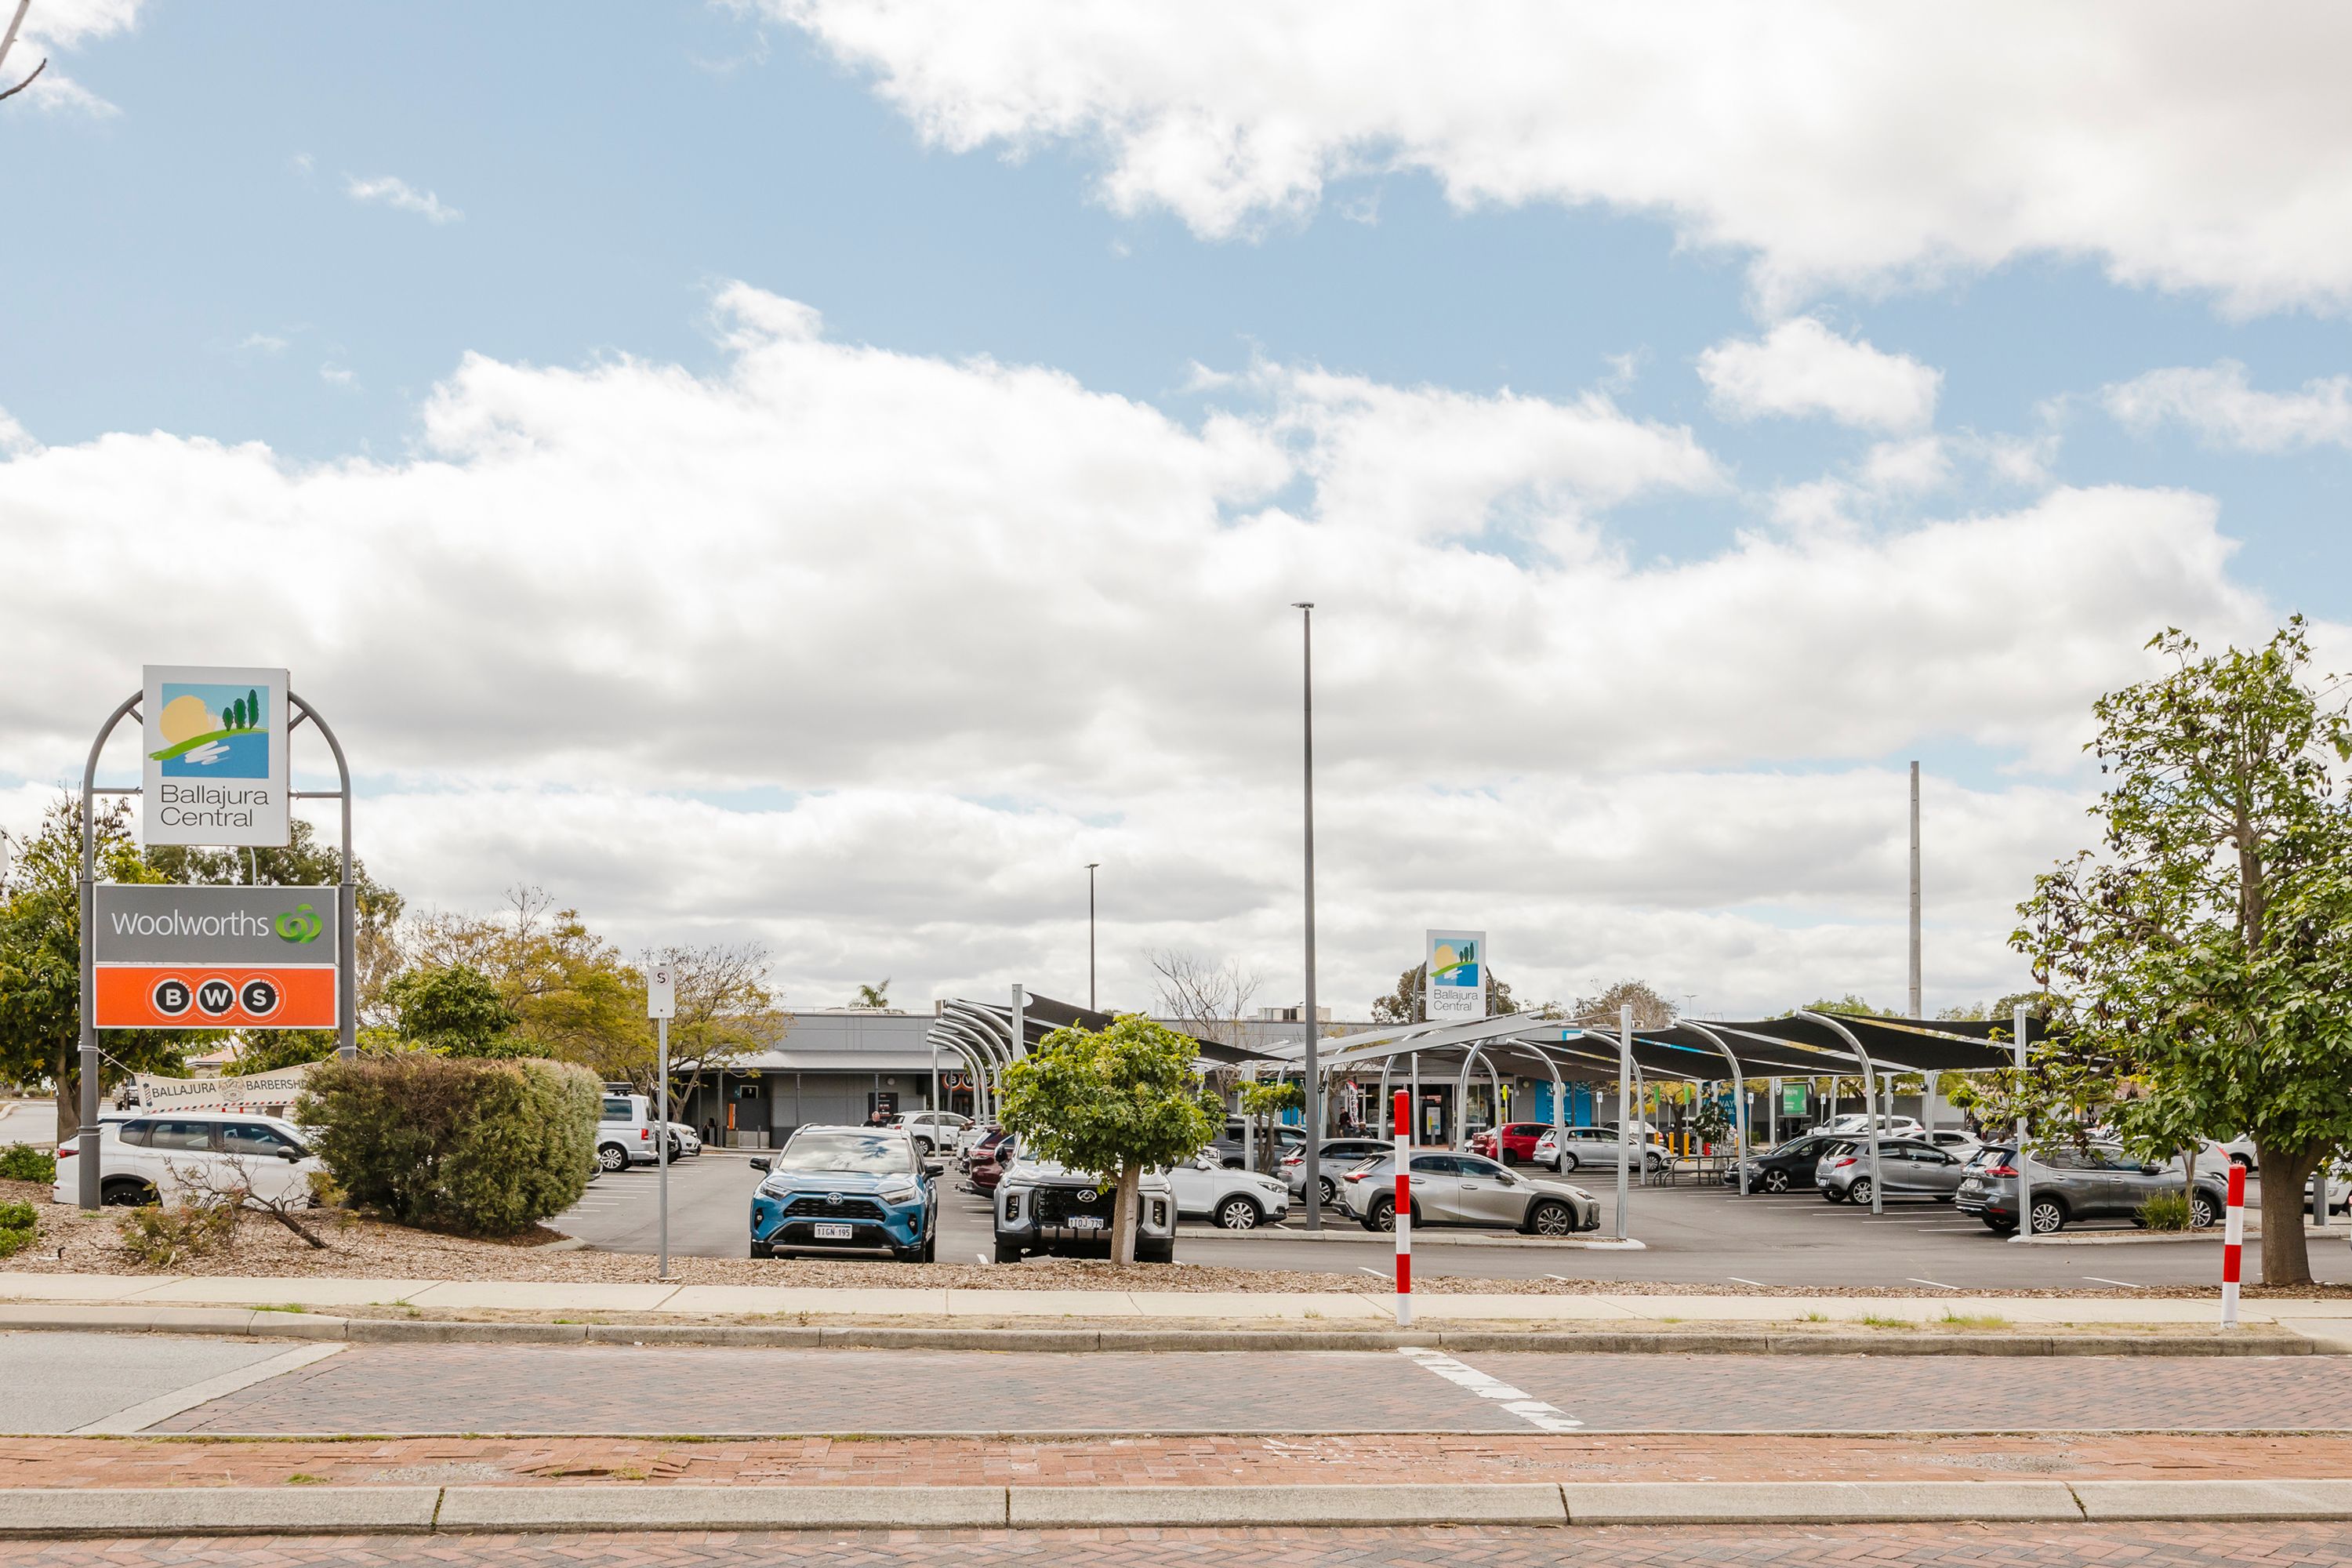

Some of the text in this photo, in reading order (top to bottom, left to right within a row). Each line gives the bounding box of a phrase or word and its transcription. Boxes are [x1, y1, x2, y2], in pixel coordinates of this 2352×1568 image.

[161, 784, 269, 809] Ballajura
[161, 807, 252, 827] Central
[111, 909, 269, 936] Woolworths
[1434, 989, 1479, 1002] Ballajura
[1433, 1000, 1472, 1011] Central
[153, 1082, 216, 1098] BALLAJURA
